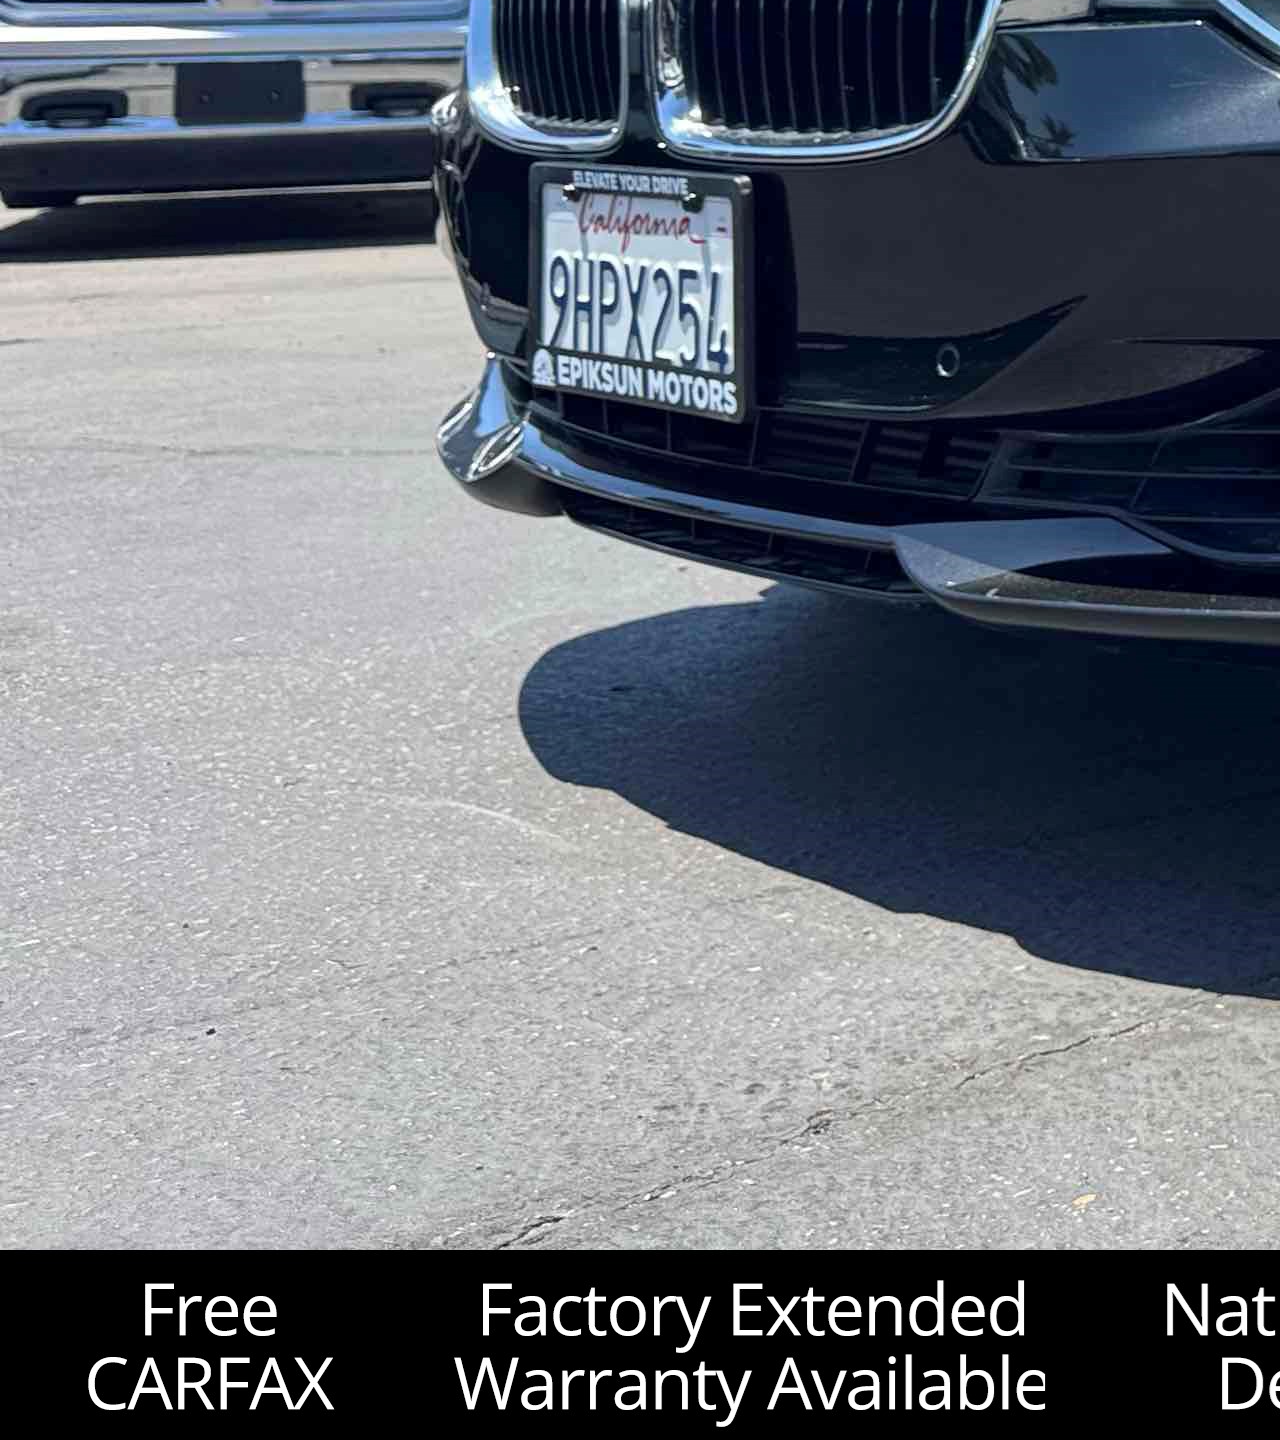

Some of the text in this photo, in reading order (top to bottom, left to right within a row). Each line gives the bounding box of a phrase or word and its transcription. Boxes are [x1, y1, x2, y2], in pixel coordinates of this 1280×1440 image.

[573, 170, 689, 195] ELEVATE YOUR DRIVE
[578, 192, 704, 254] California
[549, 255, 729, 373] 9HPX254
[556, 354, 738, 415] EPIKSUN MOTORS
